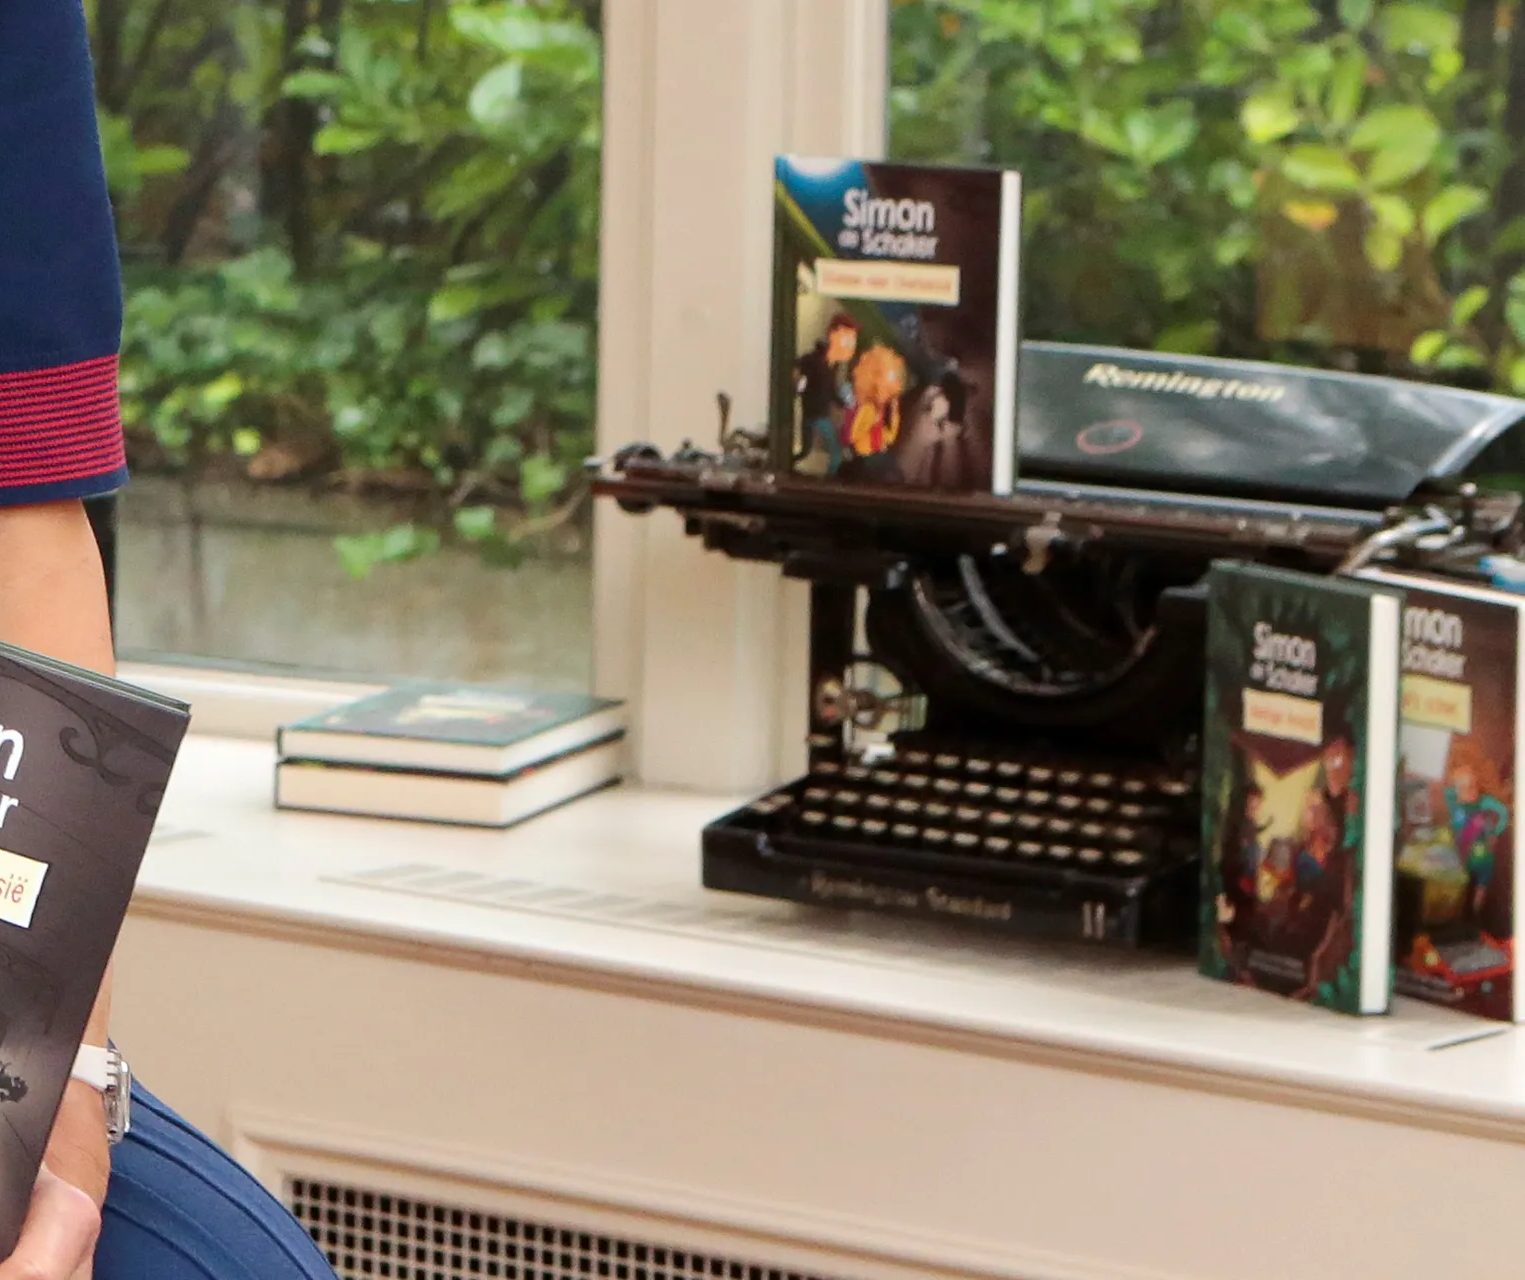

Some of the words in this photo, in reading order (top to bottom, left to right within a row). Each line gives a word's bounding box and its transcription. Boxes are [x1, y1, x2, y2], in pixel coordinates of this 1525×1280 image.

[842, 187, 936, 232] Simon
[861, 228, 939, 259] Schaker
[1083, 363, 1286, 402] Remington
[1252, 621, 1317, 669] Simon
[1403, 606, 1463, 648] mon
